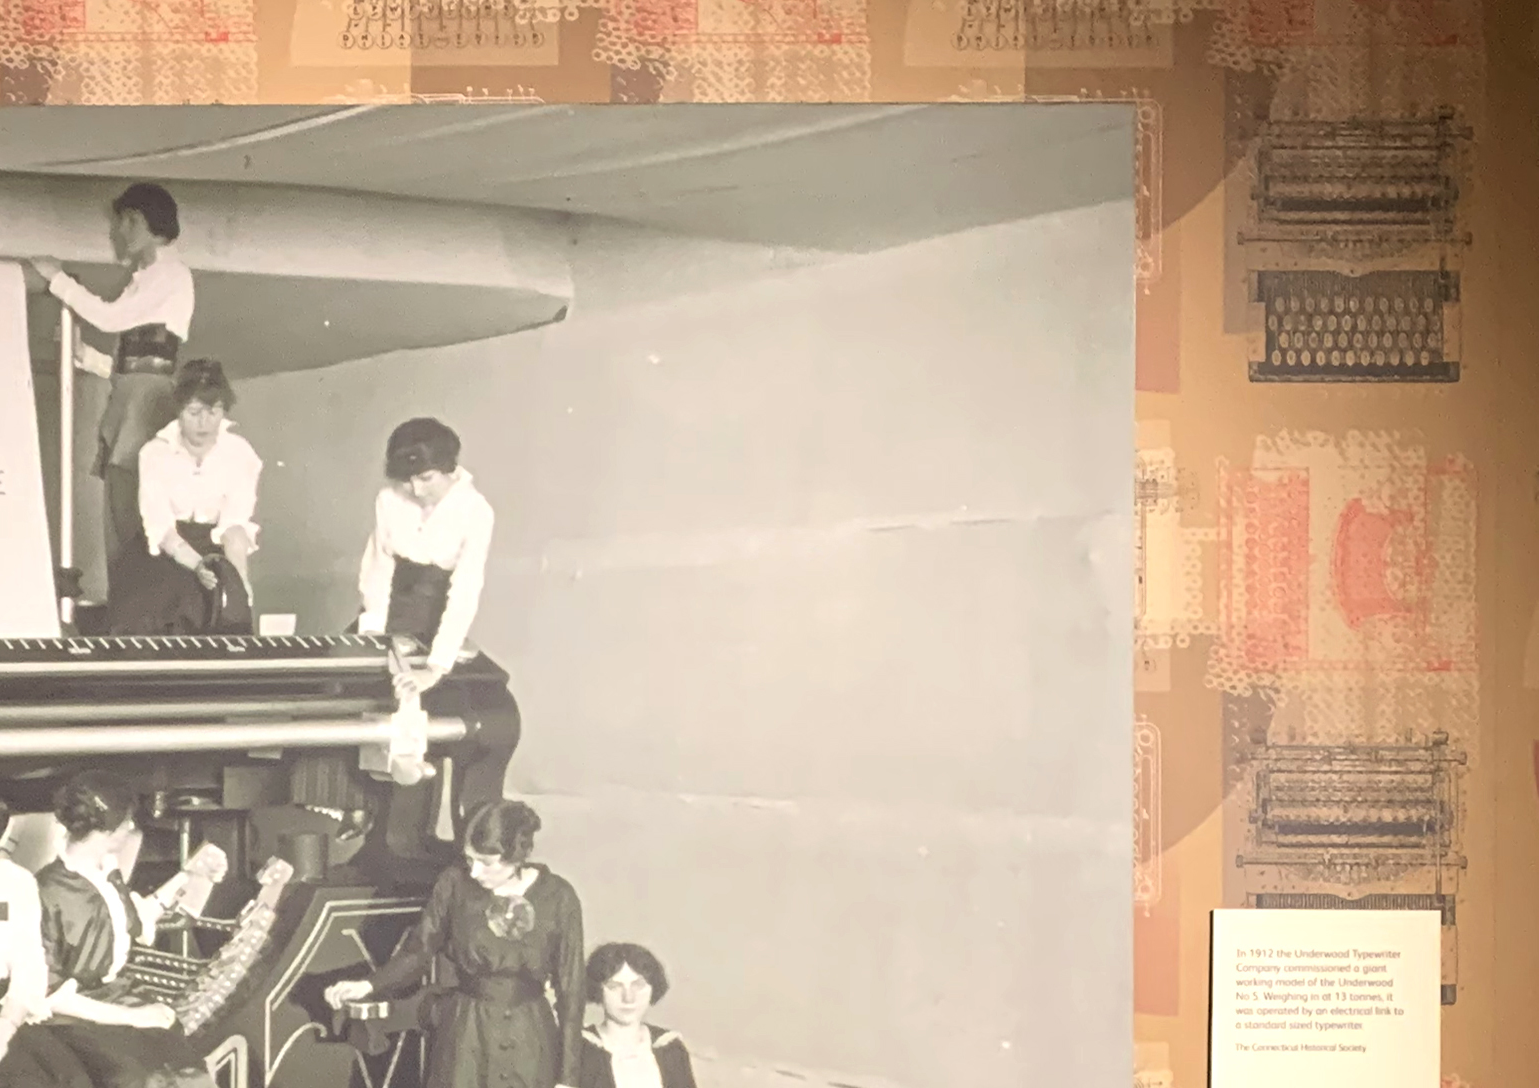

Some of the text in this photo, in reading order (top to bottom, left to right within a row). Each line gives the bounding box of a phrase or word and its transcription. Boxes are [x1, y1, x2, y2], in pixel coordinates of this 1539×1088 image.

[1237, 949, 1400, 961] In 1912 the Underwood Typewriter
[1236, 964, 1281, 974] Company
[1363, 965, 1387, 974] giant
[1236, 978, 1393, 988] working model of the Underwood
[1236, 992, 1250, 1000] No
[1263, 992, 1308, 1002] Weighing
[1311, 993, 1319, 1001] in
[1322, 993, 1331, 1001] at
[1336, 992, 1347, 1000] 13
[1387, 993, 1393, 1001] it
[1257, 1007, 1299, 1017] operated
[1302, 1007, 1313, 1017] by
[1330, 1007, 1372, 1015] electrical
[1375, 1007, 1391, 1015] link
[1245, 1021, 1286, 1029] standard
[1289, 1021, 1312, 1029] sized
[1236, 1043, 1250, 1051] The
[1339, 1043, 1366, 1053] Society
